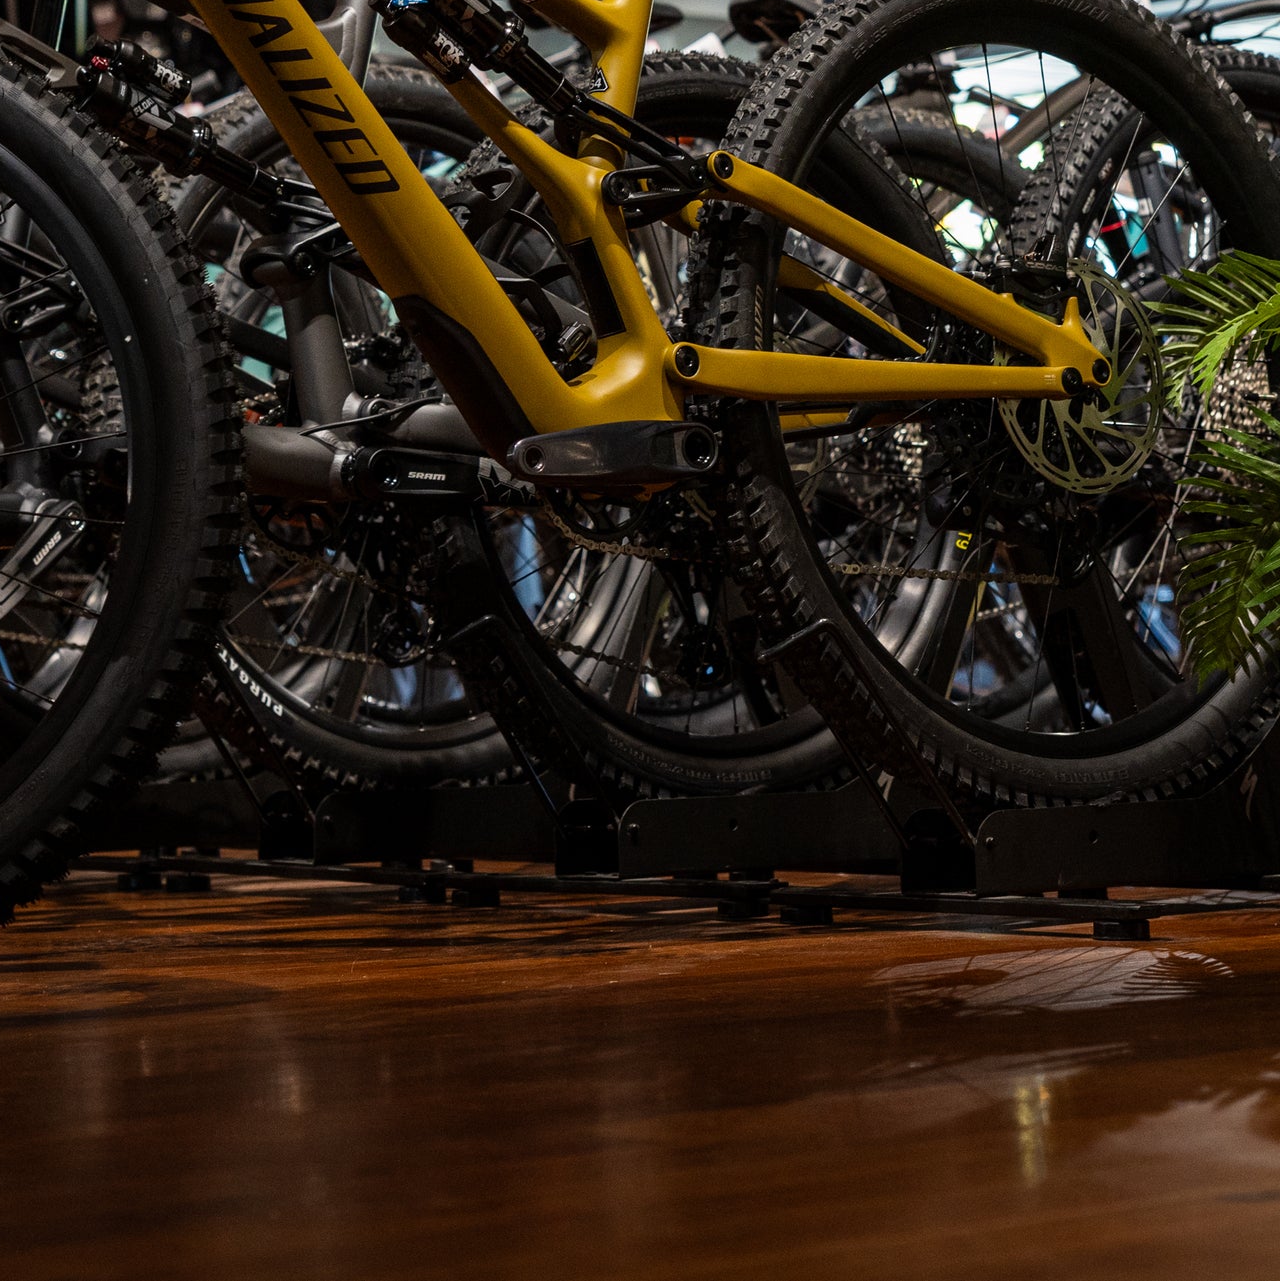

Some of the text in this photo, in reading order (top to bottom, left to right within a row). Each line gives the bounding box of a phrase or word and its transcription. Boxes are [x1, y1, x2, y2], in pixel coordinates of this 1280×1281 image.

[154, 63, 183, 94] FOX
[408, 471, 446, 481] SRAM
[32, 531, 62, 566] SRAM
[219, 649, 283, 716] PURGAT
